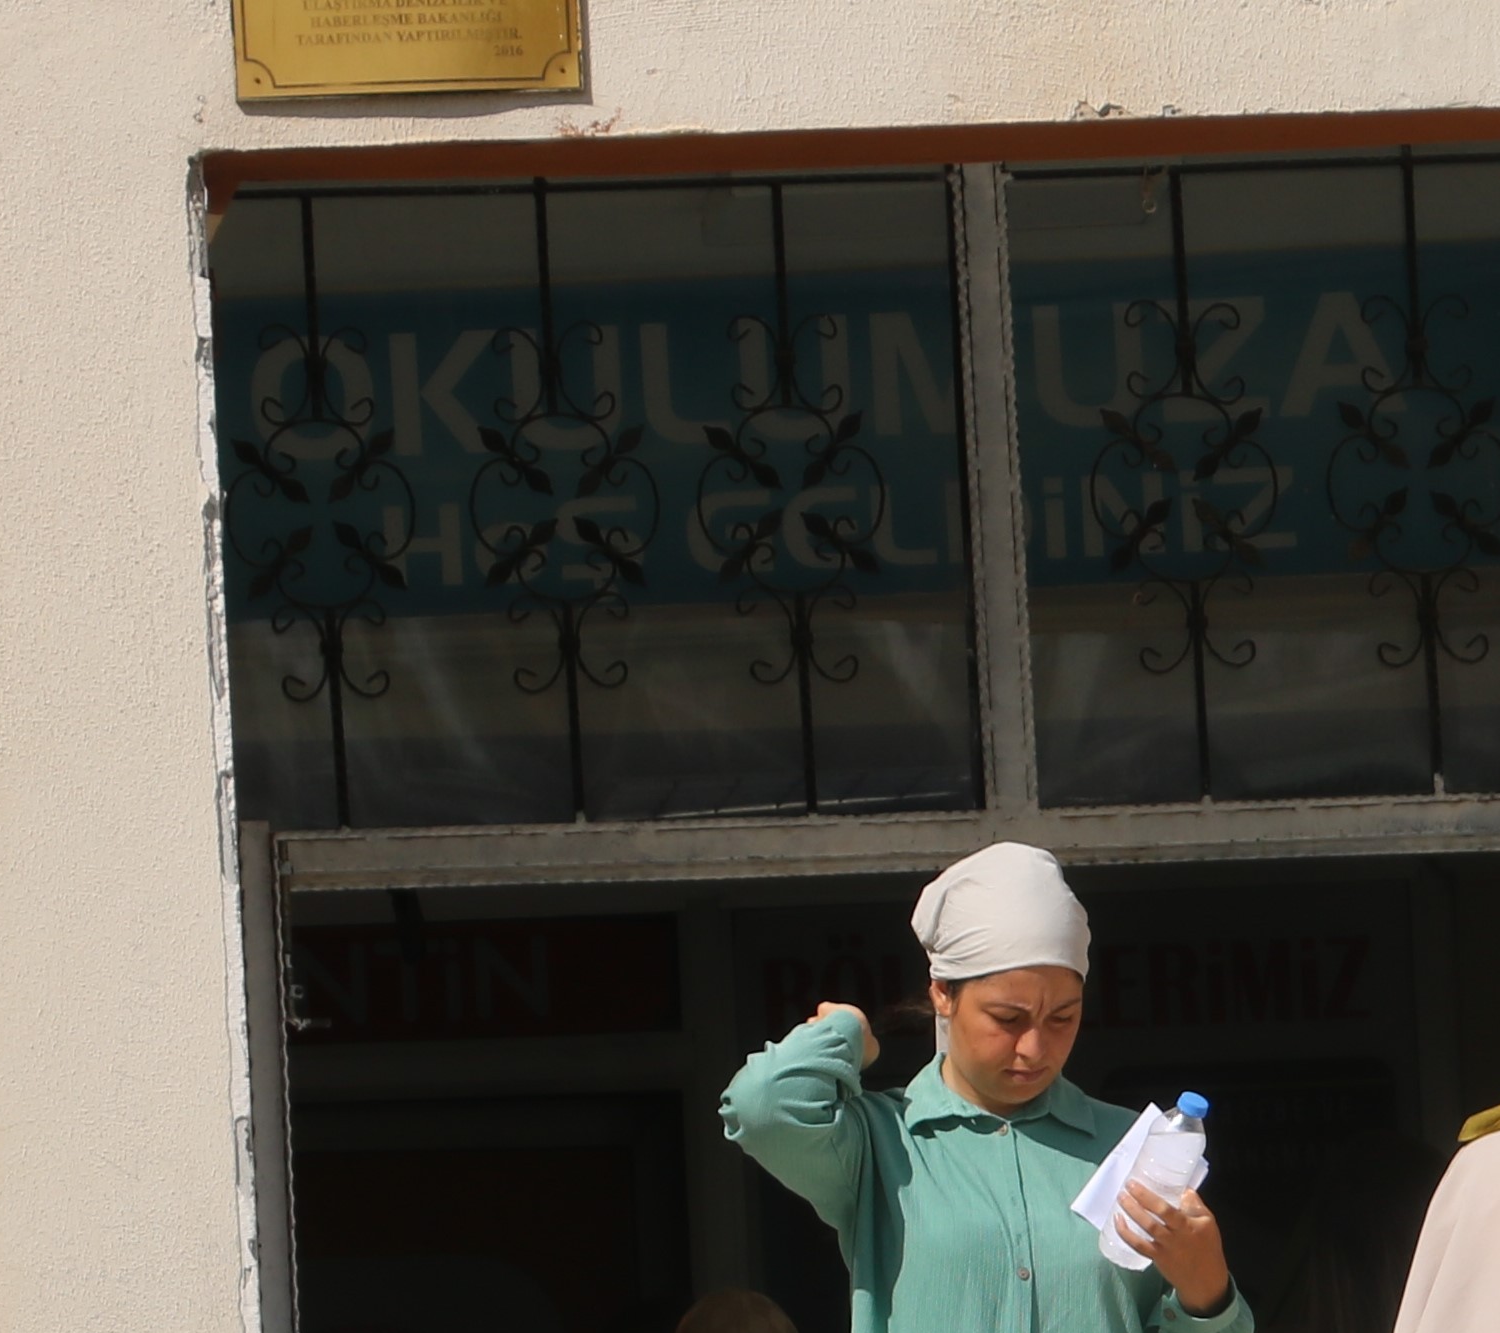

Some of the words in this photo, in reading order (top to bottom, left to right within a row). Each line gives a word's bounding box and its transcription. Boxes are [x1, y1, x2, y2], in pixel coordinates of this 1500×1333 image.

[309, 13, 414, 28] HABERLEŞME
[417, 9, 503, 25] BAKANLIĞI
[295, 30, 393, 46] TARAFINDAN
[493, 44, 524, 57] 2016
